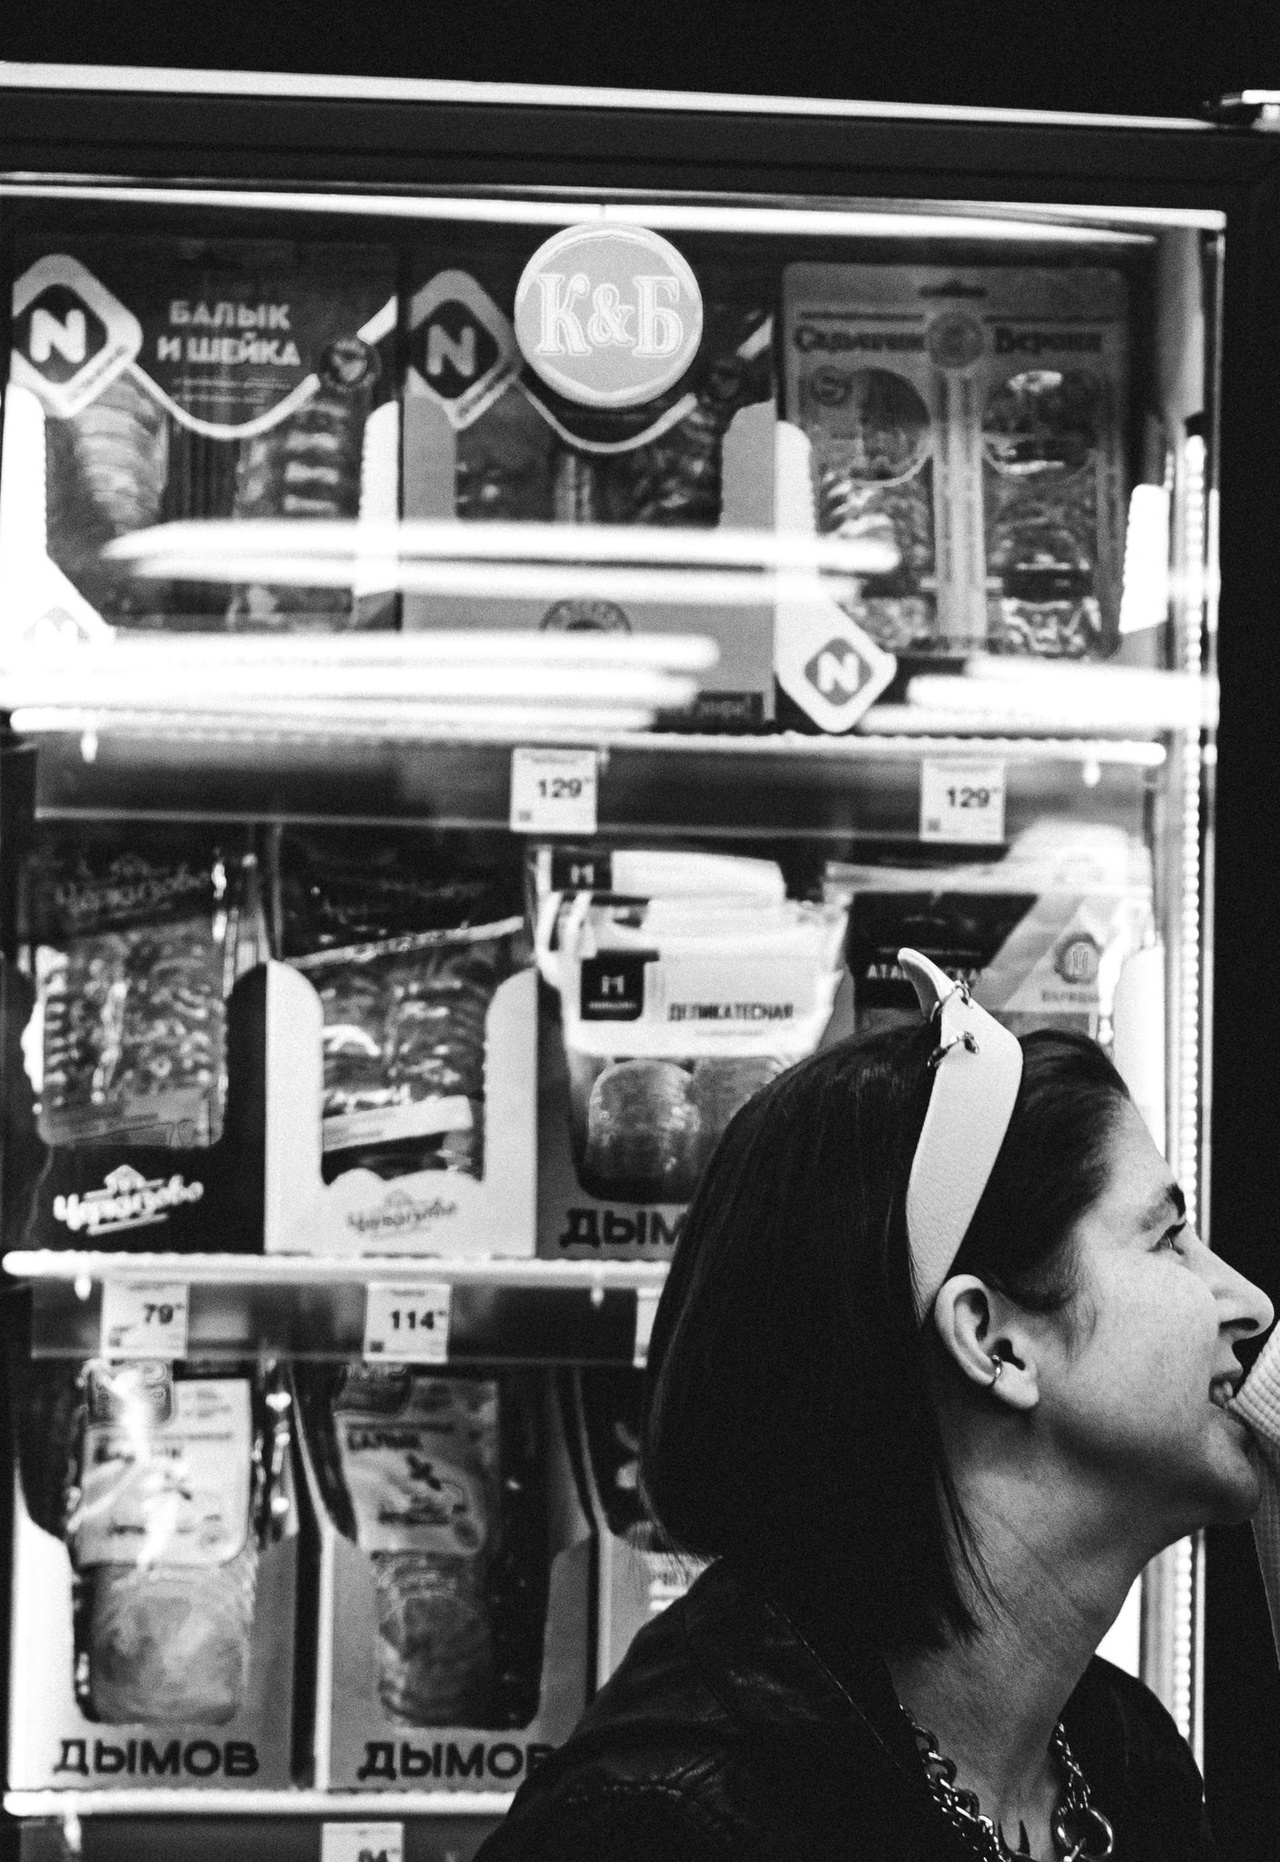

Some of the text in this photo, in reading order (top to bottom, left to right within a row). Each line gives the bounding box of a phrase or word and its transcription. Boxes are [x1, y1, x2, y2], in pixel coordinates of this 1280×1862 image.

[169, 300, 291, 331] БАЛЫК
[535, 273, 685, 358] К&Б
[29, 308, 87, 364] N
[157, 332, 301, 367] И ШЕЙКА
[426, 323, 476, 377] N
[819, 651, 860, 694] N
[538, 778, 582, 798] 129
[945, 787, 990, 809] 129
[391, 1310, 435, 1330] 114
[53, 1740, 259, 1779] ДЫМОВ
